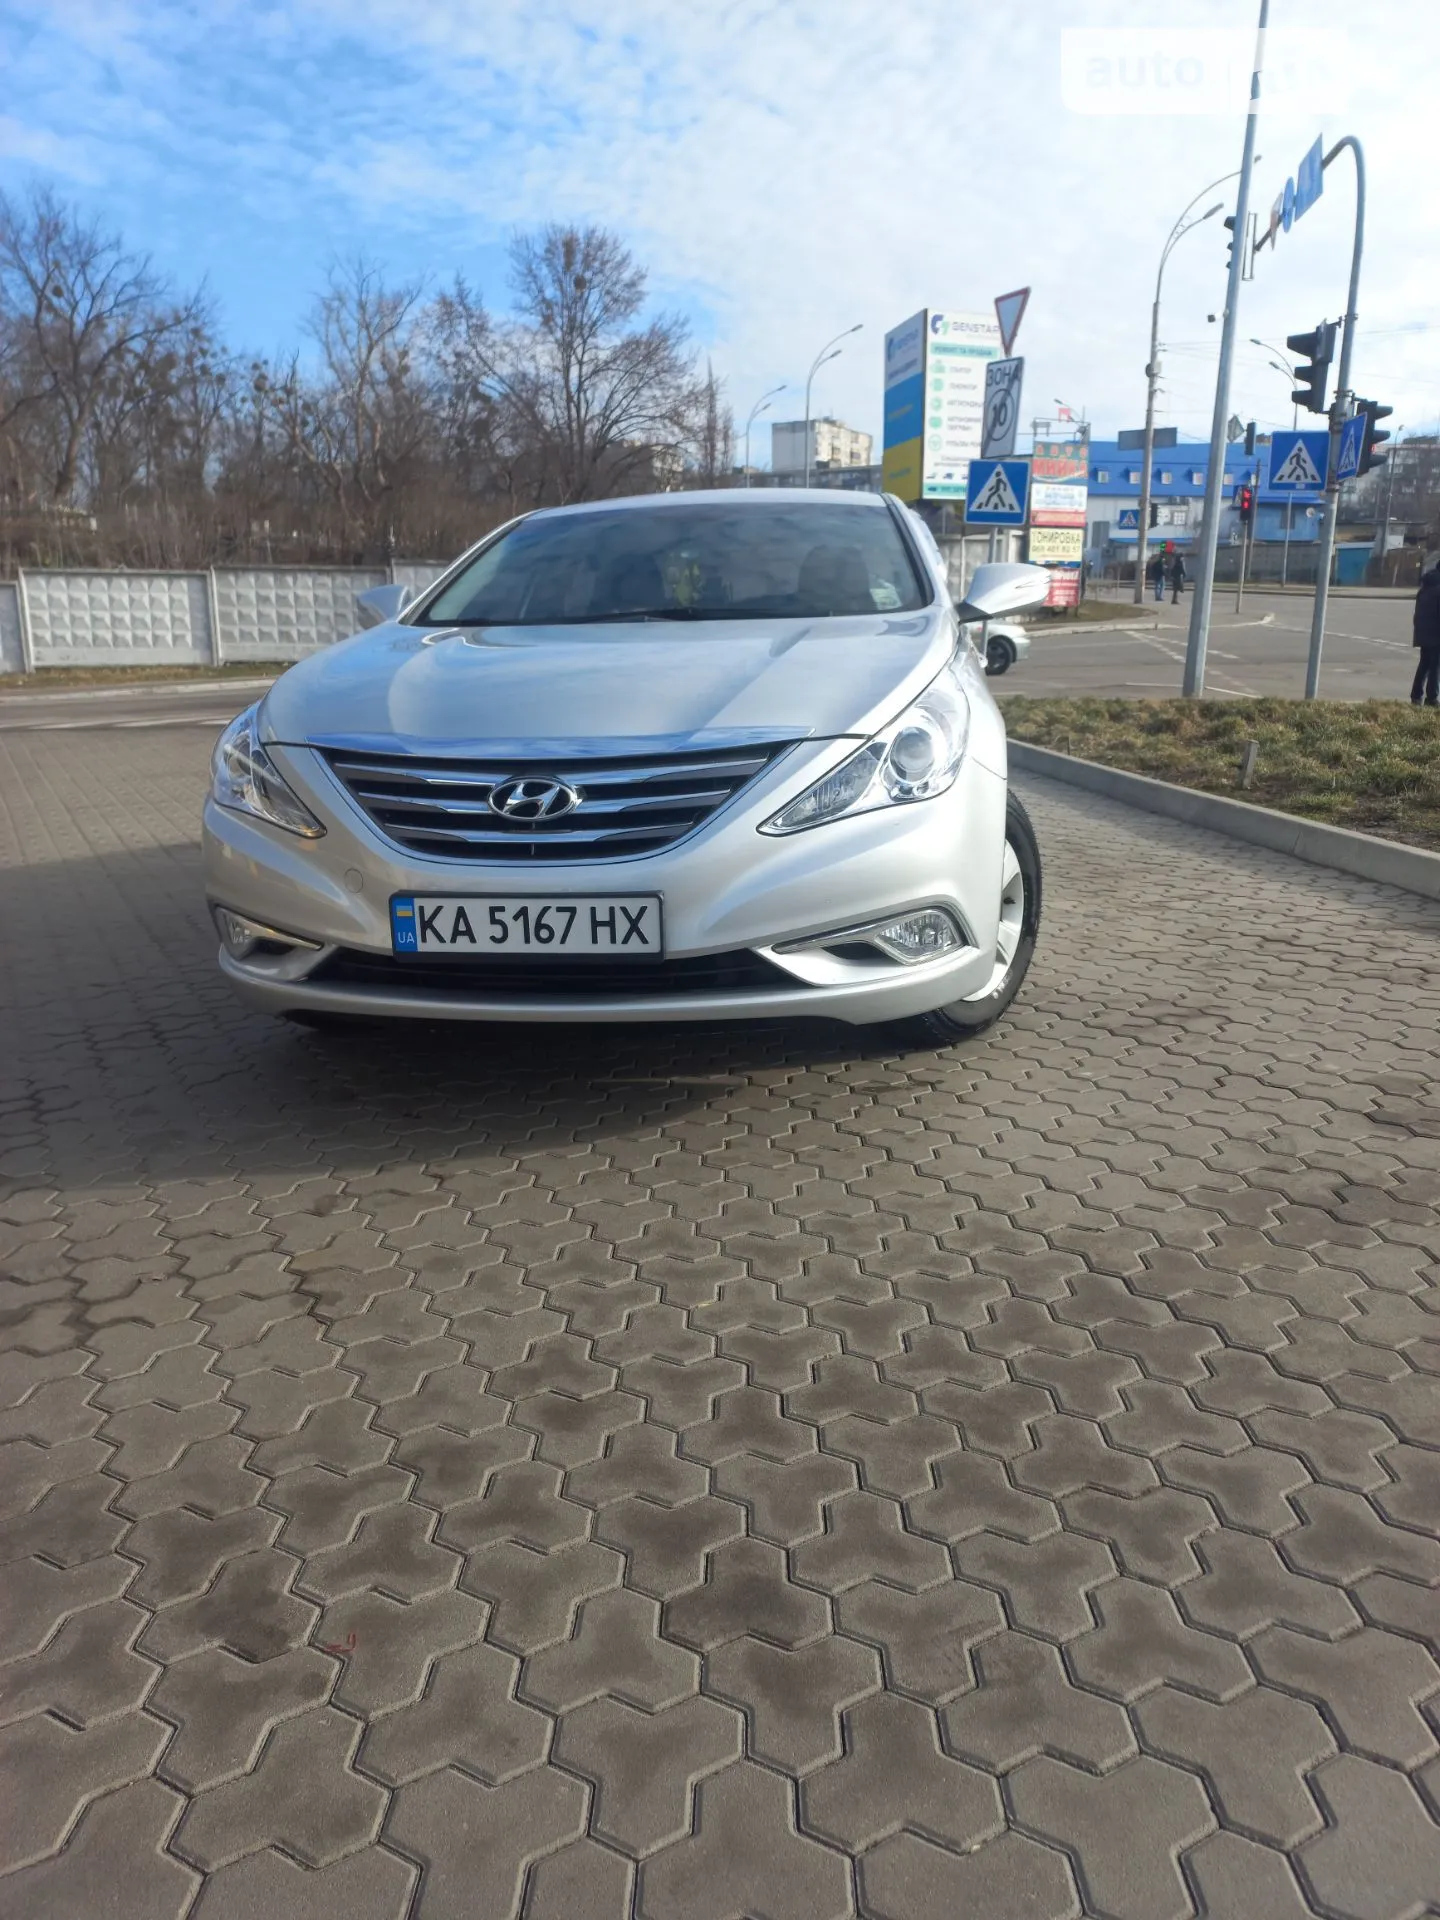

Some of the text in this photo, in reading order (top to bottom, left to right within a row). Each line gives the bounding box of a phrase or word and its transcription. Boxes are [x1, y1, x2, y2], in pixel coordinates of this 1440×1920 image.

[986, 364, 1021, 387] ЗОНА
[993, 402, 1008, 427] 10
[1032, 531, 1080, 544] ТОНИРОВКА
[418, 905, 649, 944] KA 5167 HX
[397, 931, 415, 944] UA
